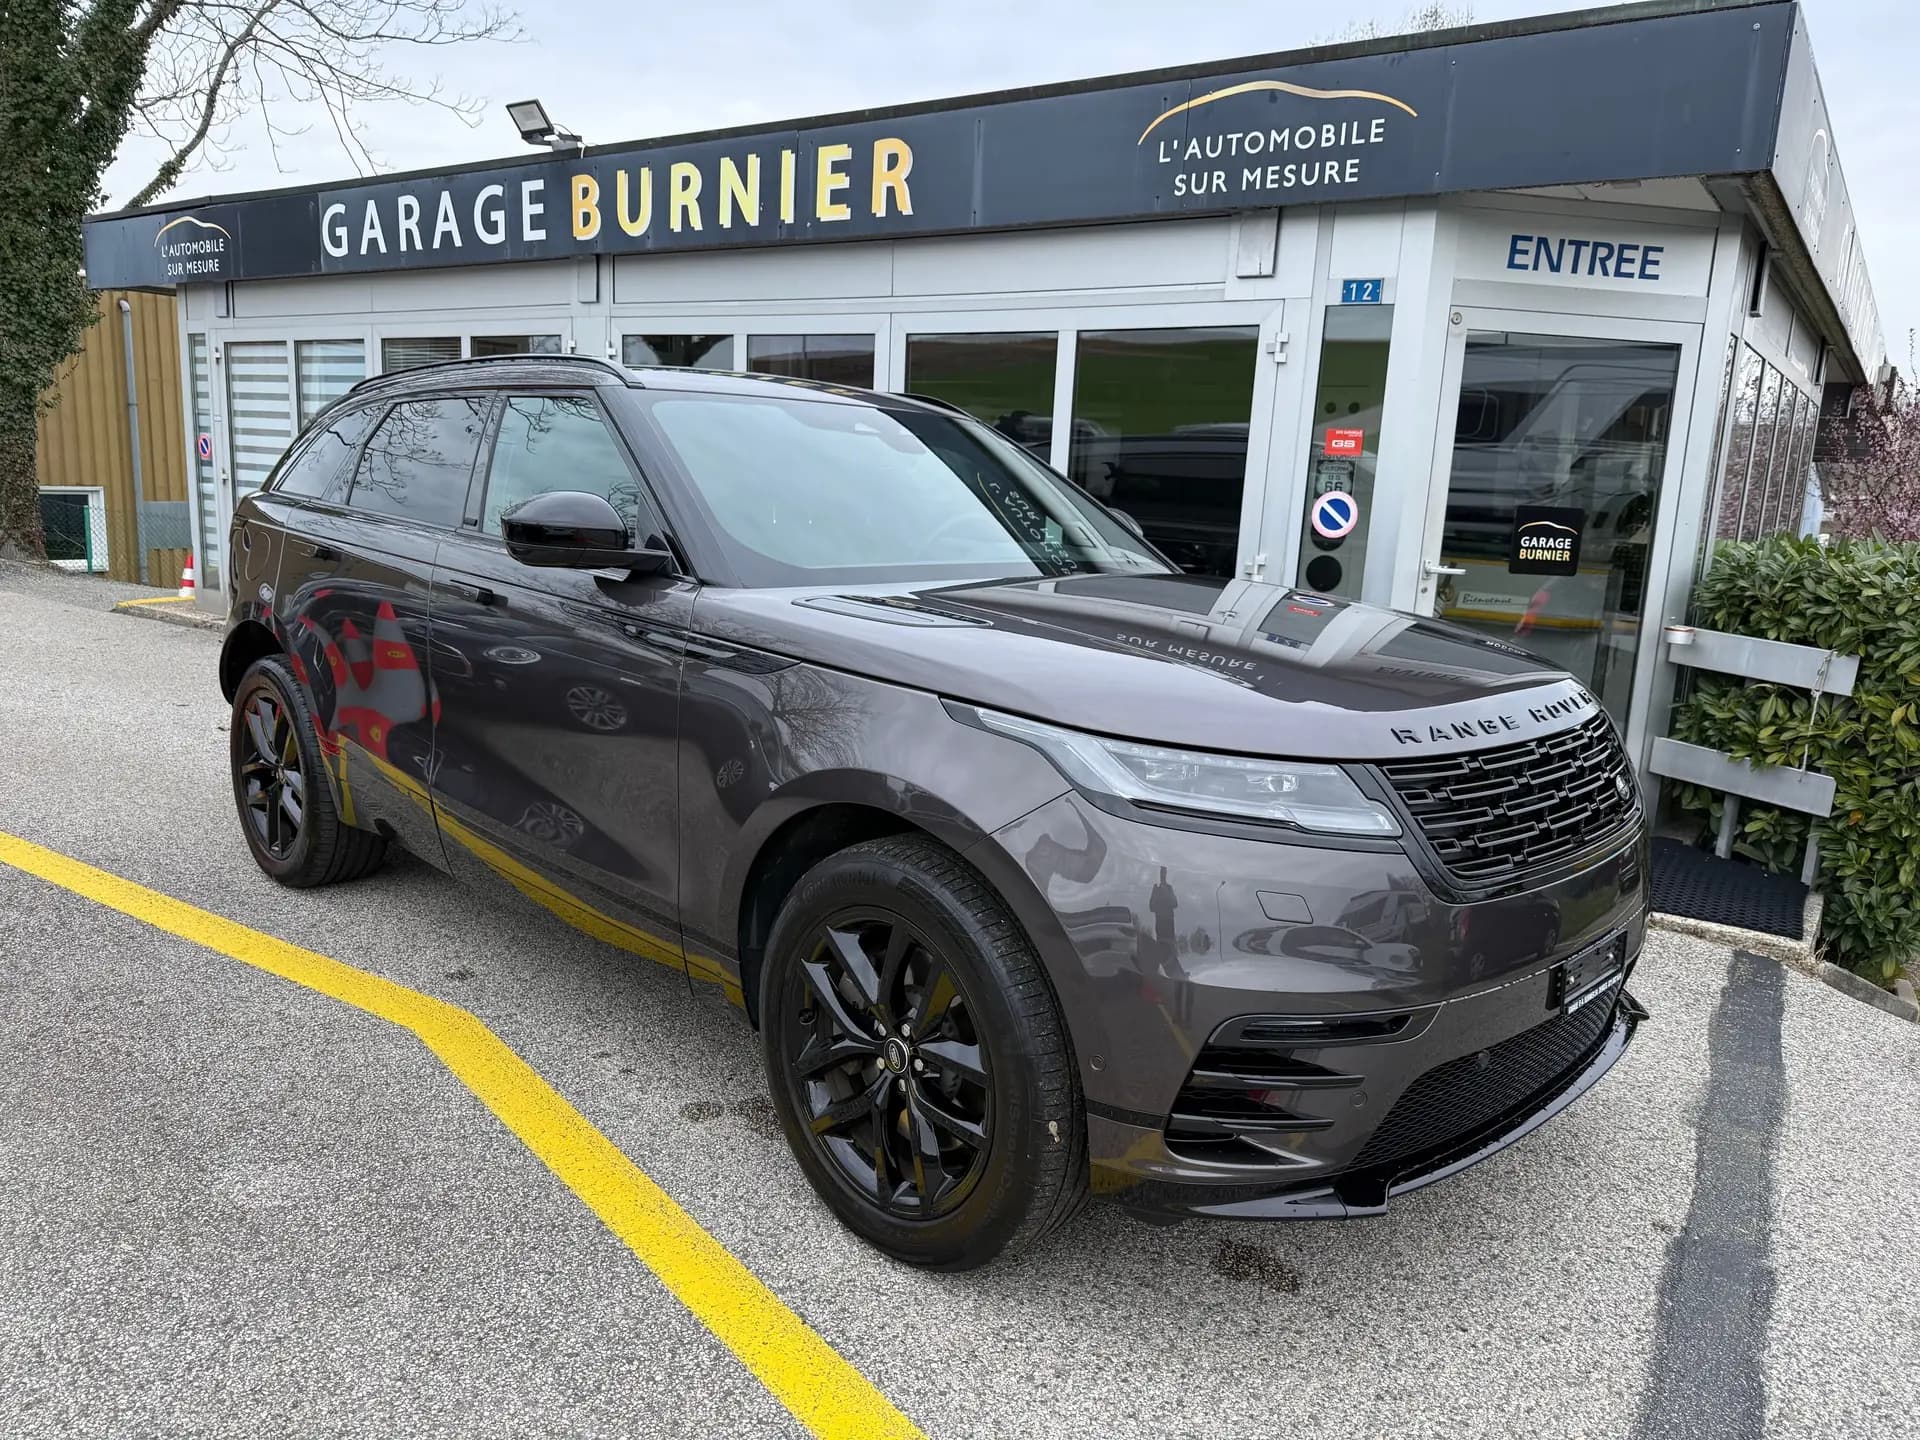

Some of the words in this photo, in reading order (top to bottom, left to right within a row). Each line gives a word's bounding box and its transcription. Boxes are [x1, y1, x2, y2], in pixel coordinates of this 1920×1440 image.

[1159, 118, 1385, 163] L'AUTOMOBILE
[1174, 170, 1227, 196] SUR
[1241, 158, 1360, 191] MESURE
[322, 178, 547, 258] GARAGE
[571, 137, 914, 241] BURNIER
[161, 238, 224, 258] L'AUTOMOBILE
[1506, 234, 1664, 280] ENTREE
[167, 262, 184, 276] SUR
[186, 259, 220, 274] MESURE
[1519, 549, 1571, 562] BURNIER
[1520, 536, 1572, 549] GARAGE
[1390, 714, 1521, 745] RANGE
[1528, 688, 1594, 723] ROVER
